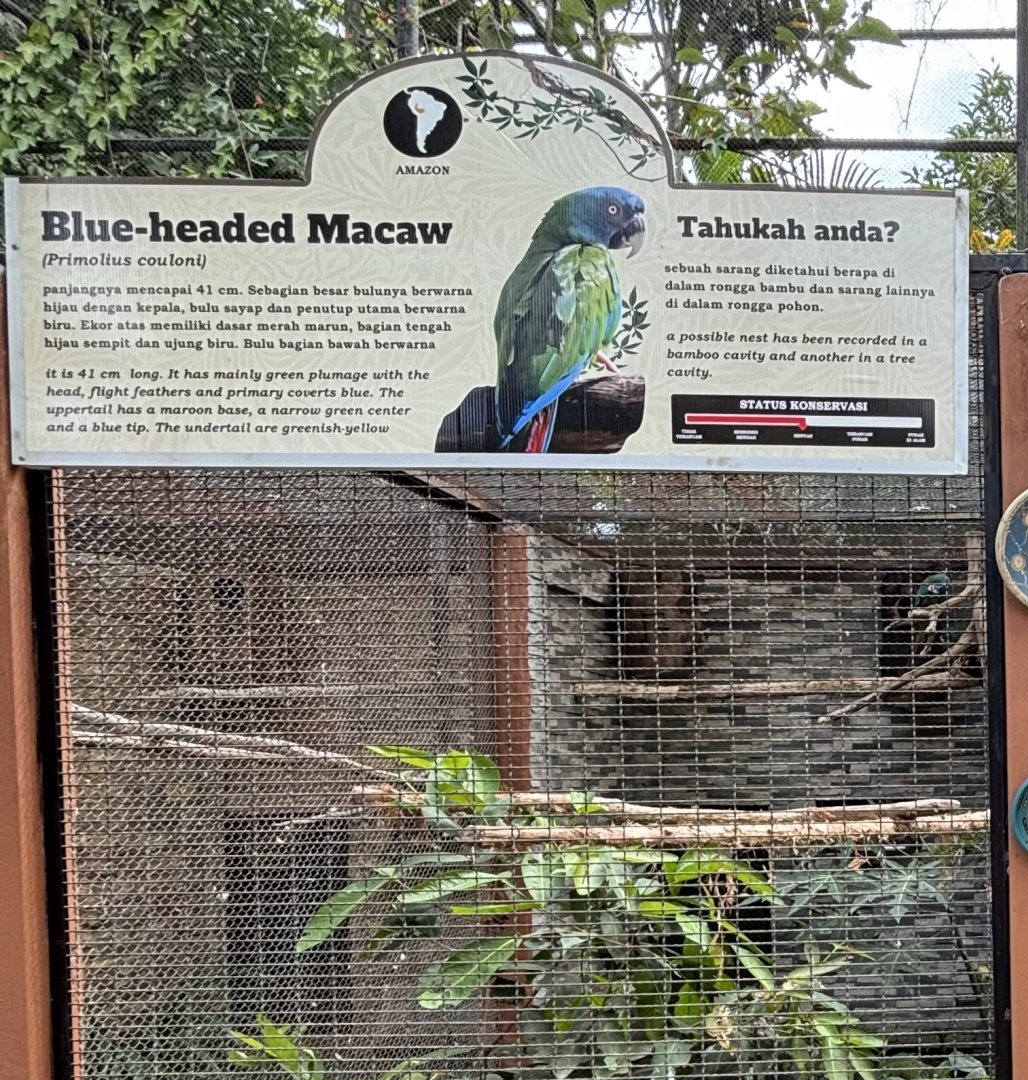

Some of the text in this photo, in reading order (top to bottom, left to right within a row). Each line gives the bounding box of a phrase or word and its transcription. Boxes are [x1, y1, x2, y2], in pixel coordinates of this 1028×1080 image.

[395, 165, 449, 175] AMAZON
[41, 210, 452, 244] Blue-headed Macaw
[676, 215, 899, 242] Tahukah anda?
[42, 252, 206, 269] (Primolius couloni)
[664, 262, 895, 280] sebuah sarang diketahui berapa di
[42, 283, 472, 298] panjangnya mencapai 41 cm. Sebagian besar bulunya berwarna
[664, 280, 935, 299] dalam rongga bambu dan sarang lainnya
[665, 298, 823, 313] di dalam rongga pohon.
[44, 337, 435, 351] hijau sempit dan ujung biru. Bulu bagian bawah berwarna
[666, 331, 927, 346] a possible nest has been recorded in a
[666, 348, 915, 363] bamboo cavity and another in a tree
[46, 368, 429, 382] it is 41 cm long. It has mainly green plumage with the
[667, 366, 712, 380] cavity.
[739, 399, 867, 411] STATUS KONSERVASI
[46, 421, 389, 435] and a blue tip. The undertail are greenish-yellow
